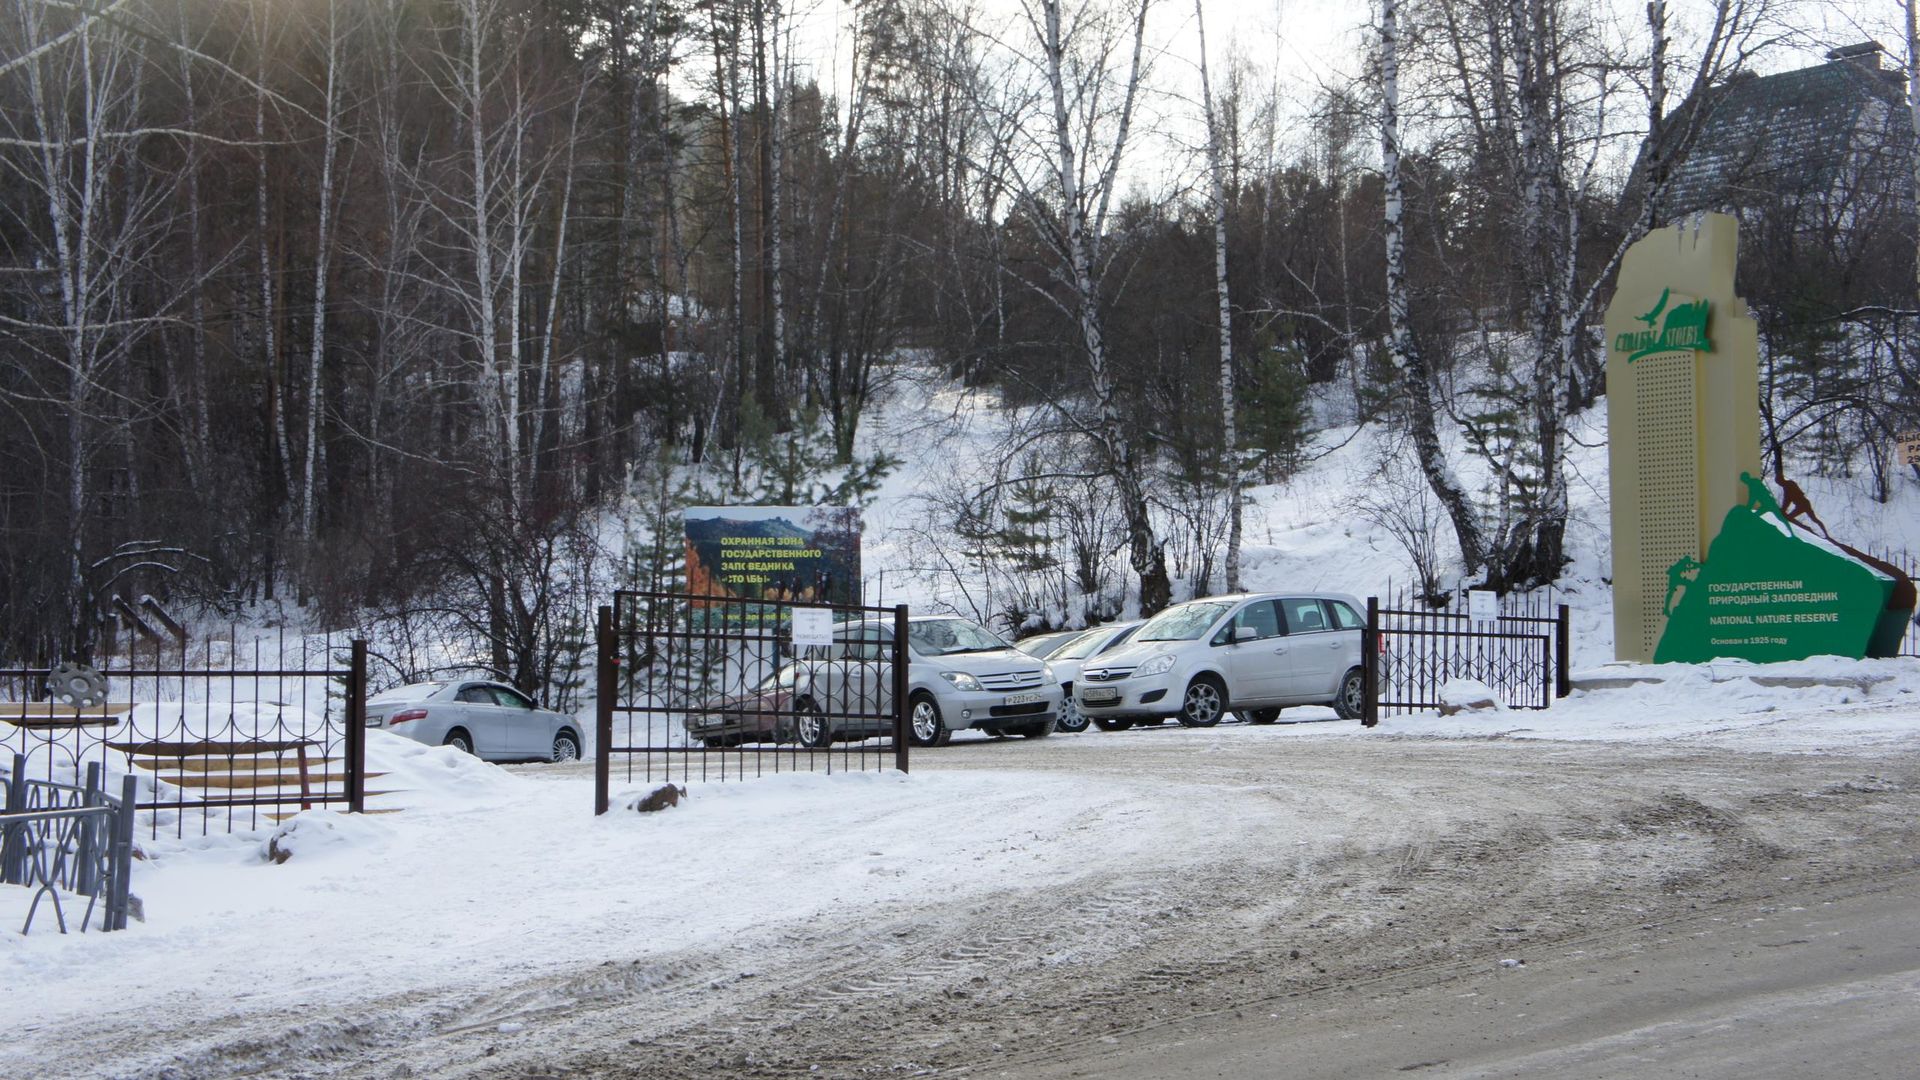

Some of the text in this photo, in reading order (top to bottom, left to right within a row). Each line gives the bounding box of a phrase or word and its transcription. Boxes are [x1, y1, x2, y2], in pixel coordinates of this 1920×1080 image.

[721, 537, 804, 546] ОХРАННАЯ ЗОНА
[721, 550, 822, 559] ГОСУДАРСТВЕННОГО
[1709, 592, 1838, 605] ПРИРОДНЫЙ ЗАПОВЕДНИК
[1709, 613, 1838, 625] NATIONAL NATURE RESERVE
